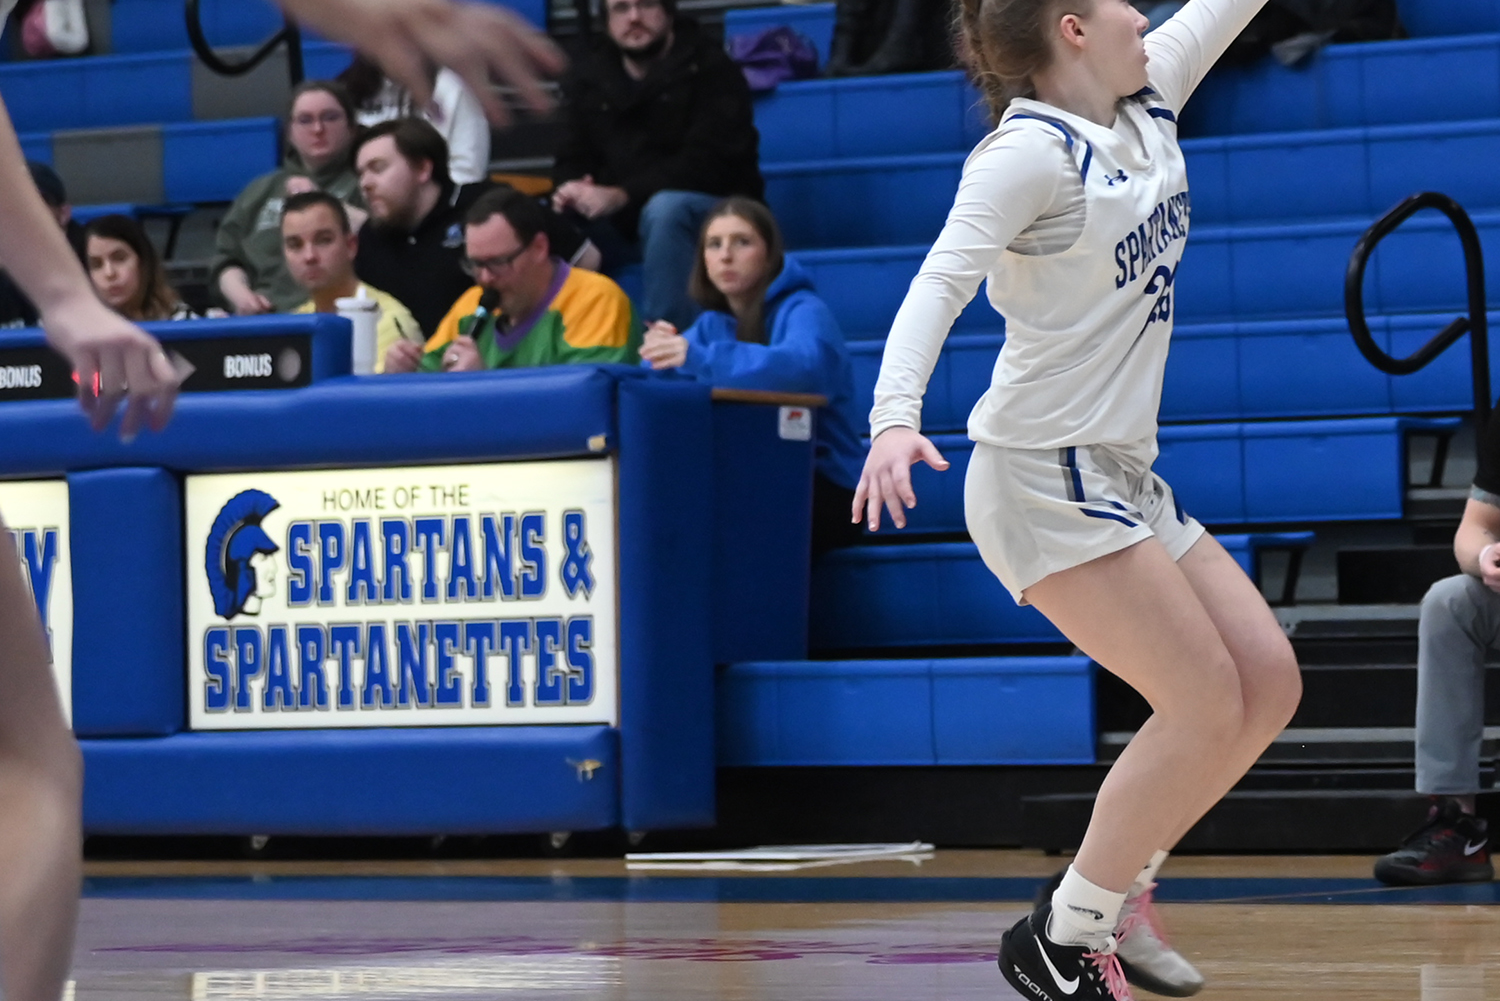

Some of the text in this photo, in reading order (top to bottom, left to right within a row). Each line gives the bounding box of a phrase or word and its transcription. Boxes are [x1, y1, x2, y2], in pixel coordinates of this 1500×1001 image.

[223, 353, 273, 378] BONUS
[322, 484, 471, 511] HOME OF THE
[286, 508, 597, 609] SPARTANS &
[203, 614, 596, 714] SPARTANETTES
